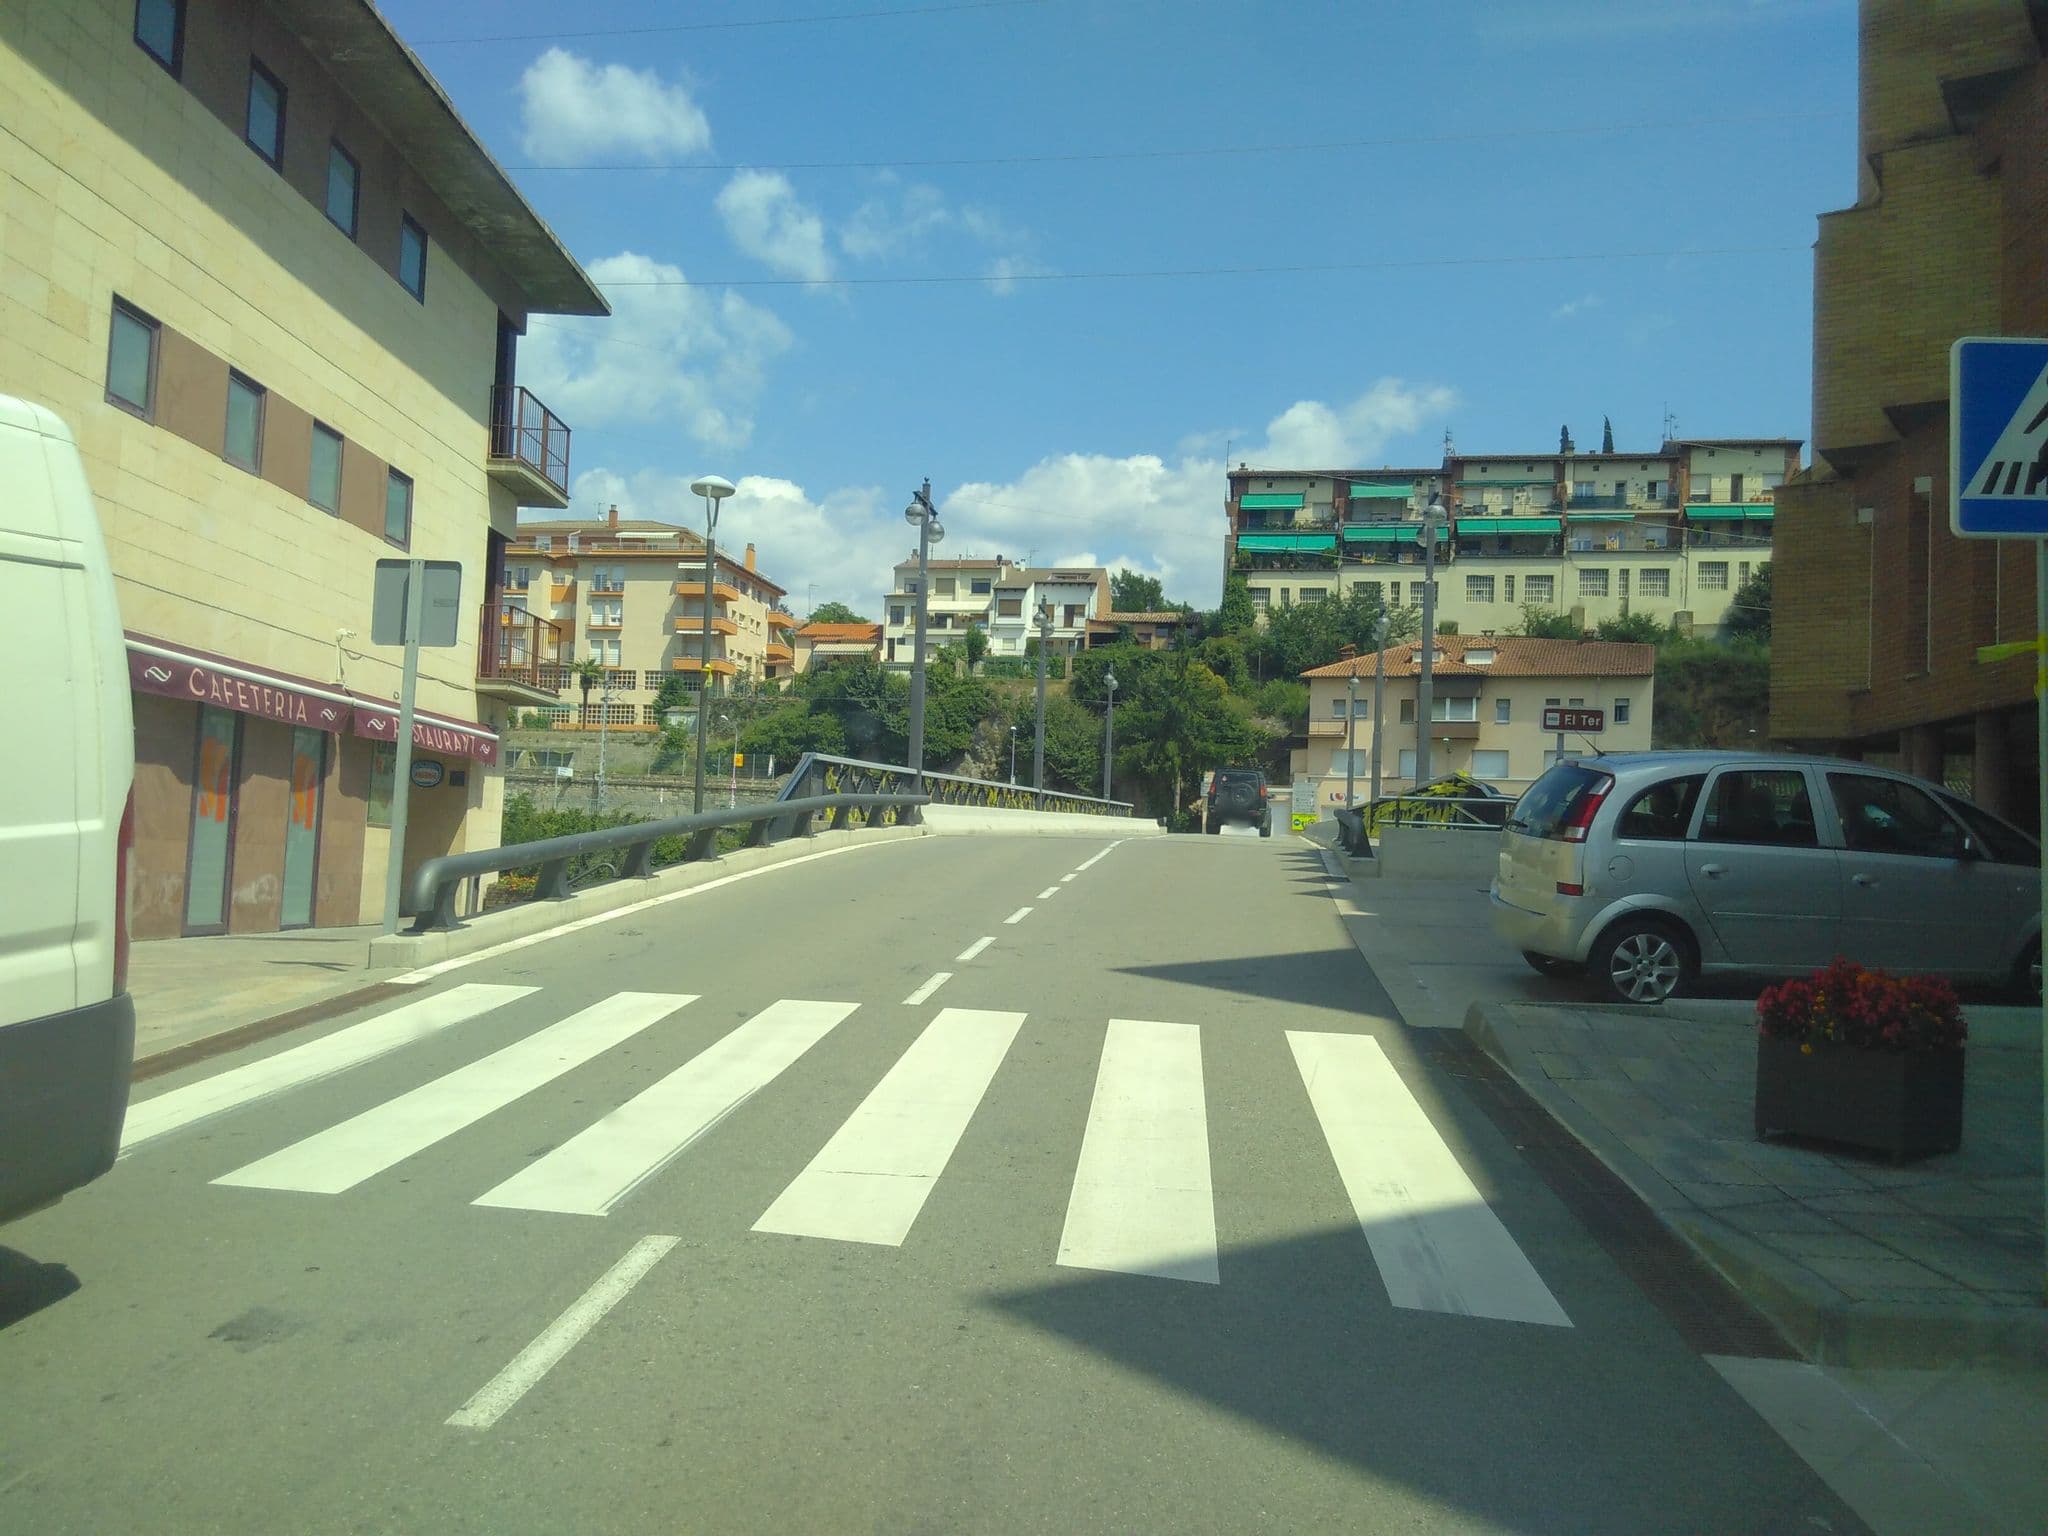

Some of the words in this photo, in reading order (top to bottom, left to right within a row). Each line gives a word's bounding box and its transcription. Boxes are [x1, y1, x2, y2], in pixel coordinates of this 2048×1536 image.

[189, 667, 307, 722] CAFETERIA
[392, 716, 476, 754] RSTAURANT
[1564, 714, 1576, 726] El
[1580, 714, 1601, 727] Ter
